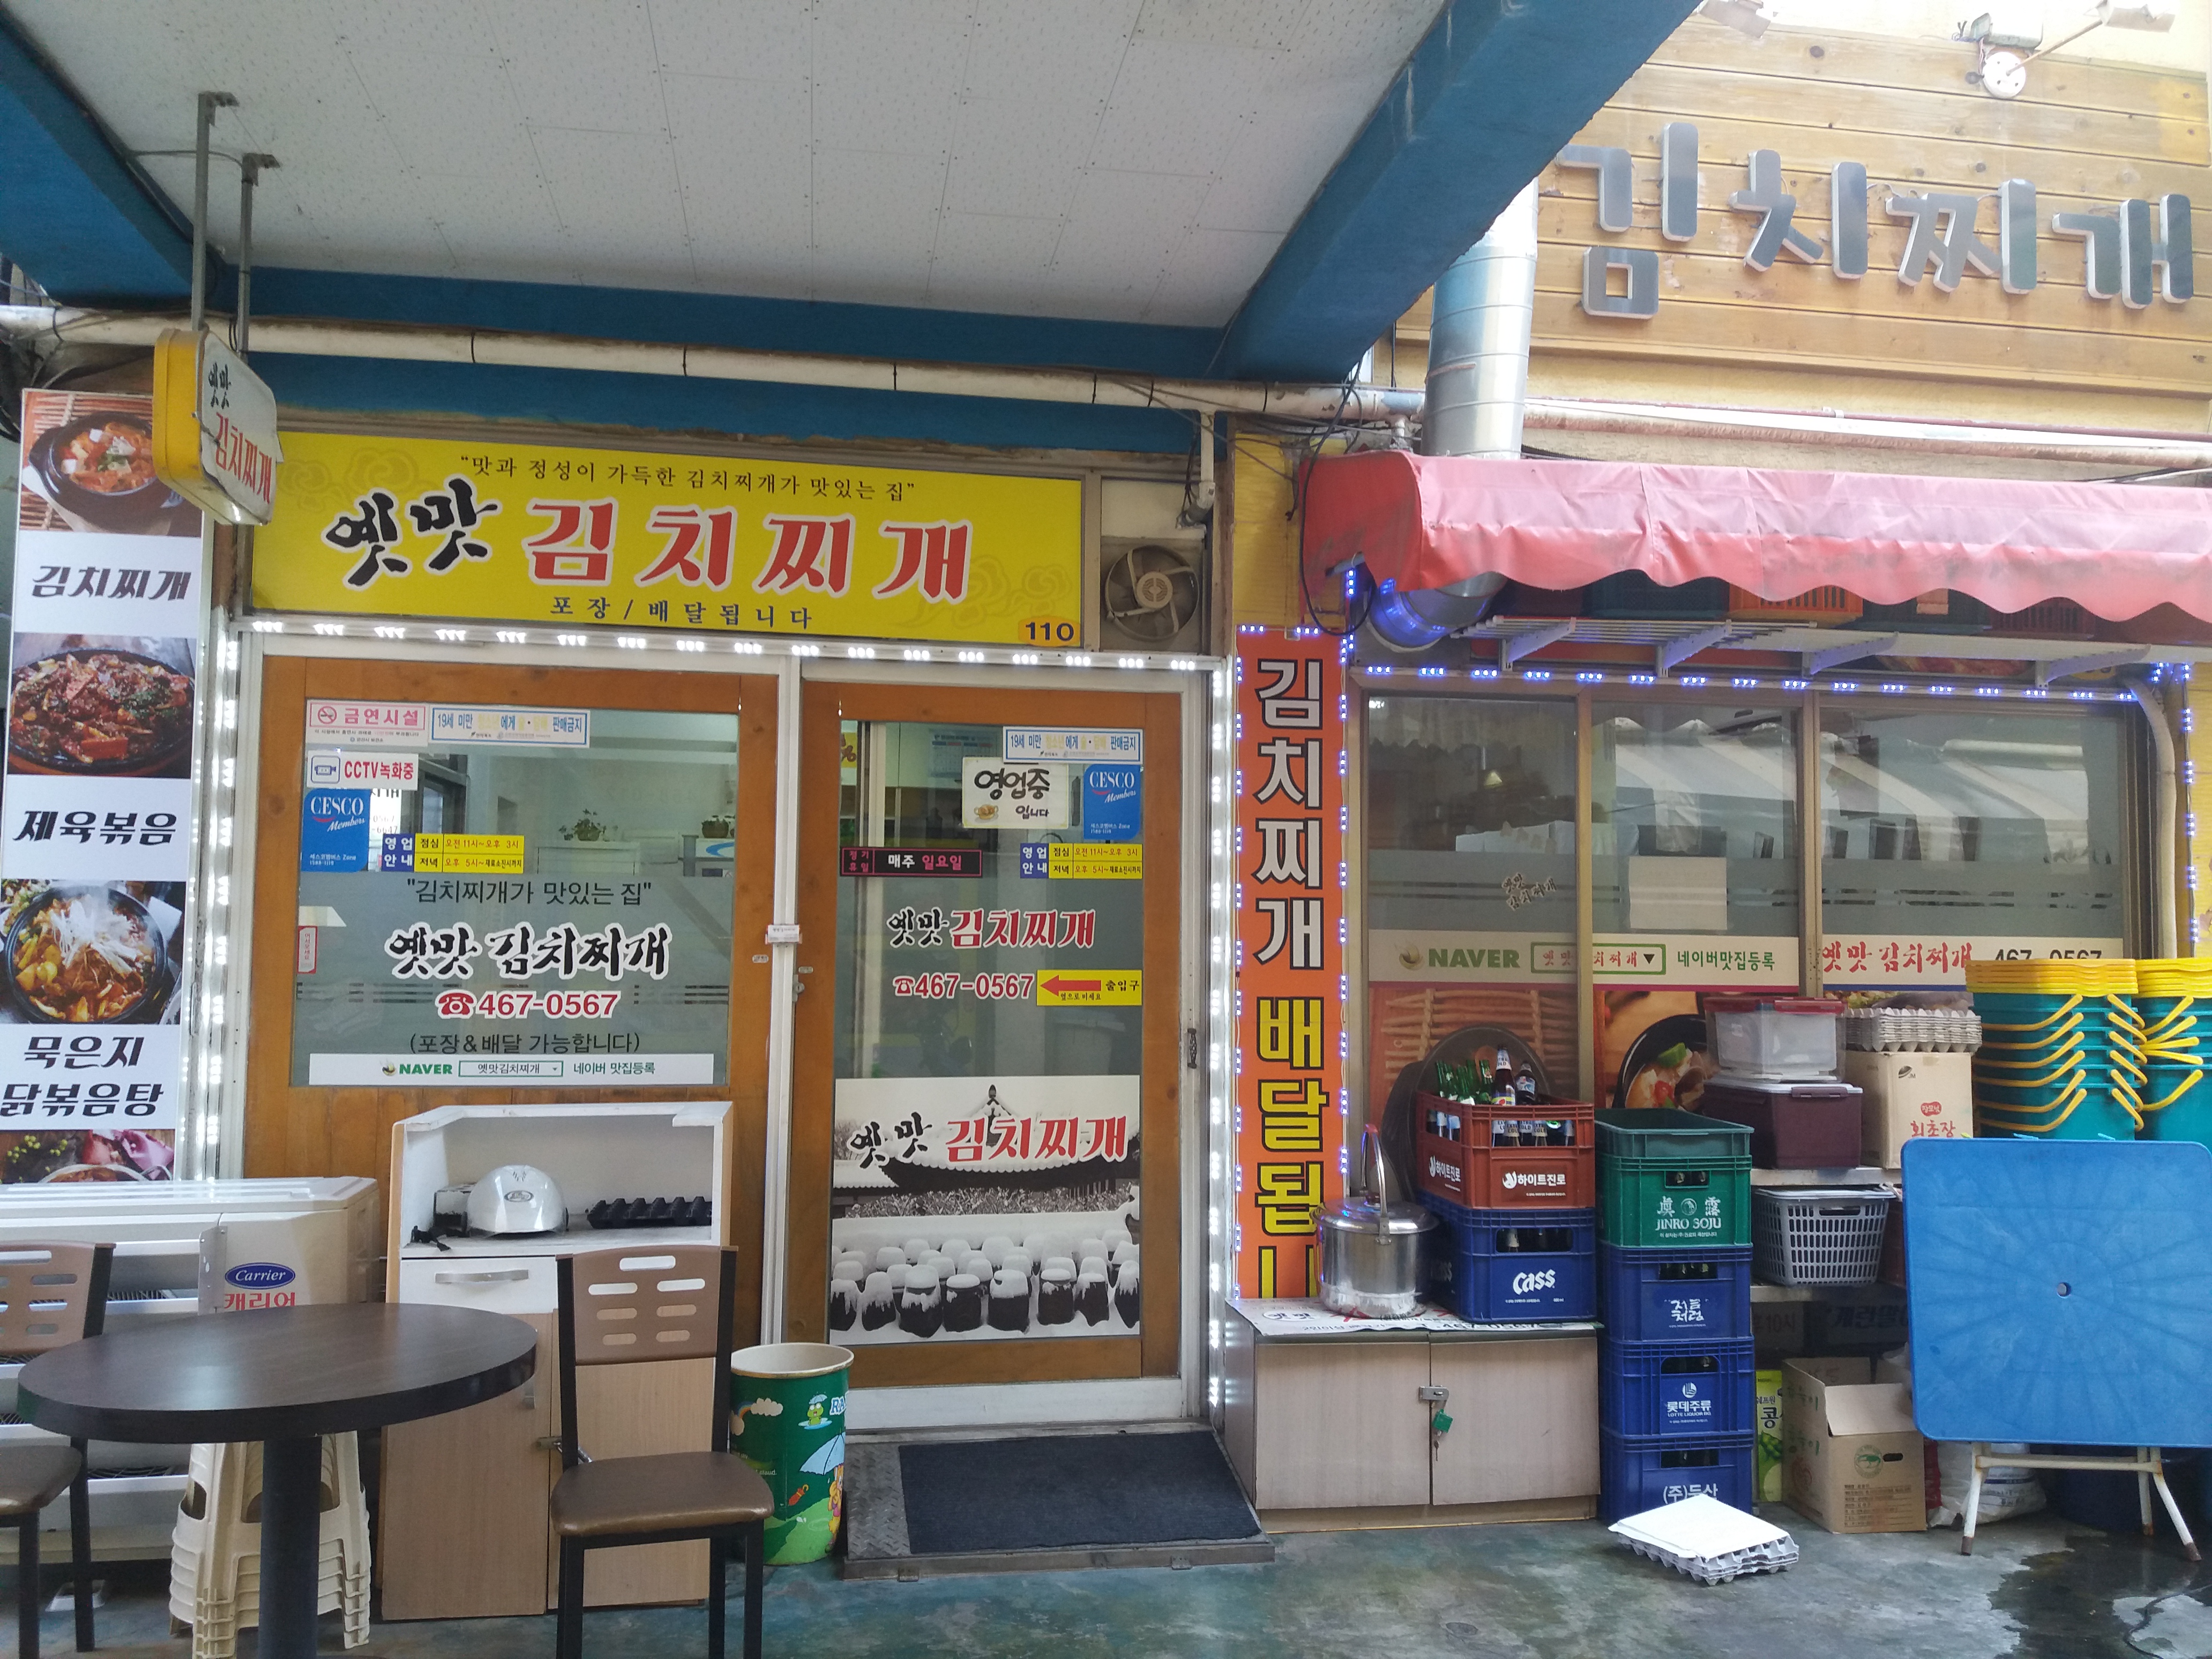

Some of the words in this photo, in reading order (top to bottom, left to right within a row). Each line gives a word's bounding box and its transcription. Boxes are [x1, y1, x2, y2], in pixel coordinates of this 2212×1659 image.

[1555, 122, 2194, 320] 김치찌개
[208, 362, 231, 408] 옛맛
[215, 412, 272, 504] 김치찌개
[529, 459, 594, 482] 정성이
[608, 464, 676, 488] 가득한
[687, 469, 800, 495] 김치찌개가
[810, 477, 875, 500] 맛있는
[527, 499, 969, 600] 김치찌개
[32, 564, 192, 601] 김치찌개
[1025, 621, 1074, 642] 110
[345, 708, 418, 727] 금연시설
[438, 713, 453, 729] 19세
[458, 713, 473, 729] 미만
[552, 716, 582, 733] 판매금지
[1011, 734, 1025, 748] 19세
[1029, 734, 1041, 749] 미만
[1110, 736, 1136, 750] 판매금지
[974, 767, 1050, 800] 영업중
[1089, 771, 1135, 788] CESCO
[310, 796, 364, 816] CESCO
[1104, 789, 1137, 803] Members
[1015, 804, 1050, 820] 입니다
[1252, 659, 1324, 970] 김치찌개
[12, 810, 177, 846] 제육볶음
[327, 816, 365, 832] Members
[421, 838, 439, 849] 점심
[446, 839, 460, 849] 오전
[506, 840, 519, 849] 3시
[1053, 848, 1070, 857] 점심
[1075, 848, 1088, 857] 오전
[1127, 848, 1138, 857] 3시
[420, 857, 438, 868] 저녁
[445, 858, 459, 867] 오후
[887, 854, 915, 869] 매주
[922, 855, 962, 871] 일요일
[1053, 865, 1070, 875] 저녁
[1075, 865, 1088, 873] 오후
[543, 881, 614, 906] 맛있는
[888, 908, 947, 946] 옛맛
[950, 909, 1095, 947] 김치찌개
[389, 926, 479, 974] 옛맛
[489, 925, 669, 976] 김치찌개
[1428, 948, 1520, 968] NAVER
[1879, 941, 1973, 974] 김치찌개
[914, 974, 1034, 998] 467-0567
[1105, 979, 1140, 992] 출입구
[479, 993, 619, 1017] 467-0567
[1082, 993, 1102, 1001] 미세요
[24, 1035, 144, 1070] 묵은지
[529, 1033, 640, 1053] 가능합니다)
[399, 1063, 453, 1075] NAVER
[477, 1062, 540, 1074] 옛맛김치찌개
[573, 1061, 607, 1075] 네이버
[609, 1061, 656, 1075] 맛집등록
[0, 1082, 164, 1117] 닭볶음탕
[1910, 1119, 1956, 1138] 회초장
[945, 1116, 1126, 1163] 김치찌개
[1436, 1160, 1461, 1183] 하이트진로
[1517, 1173, 1566, 1186] 하이트진로
[1655, 1218, 1690, 1231] JINRO
[1693, 1217, 1722, 1230] SOJU
[235, 1269, 286, 1282] Carrier
[224, 1292, 295, 1310] 캐리어
[830, 1397, 845, 1415] RA
[1667, 1400, 1712, 1413] 롯데주류
[1760, 1407, 1779, 1429] 콩
